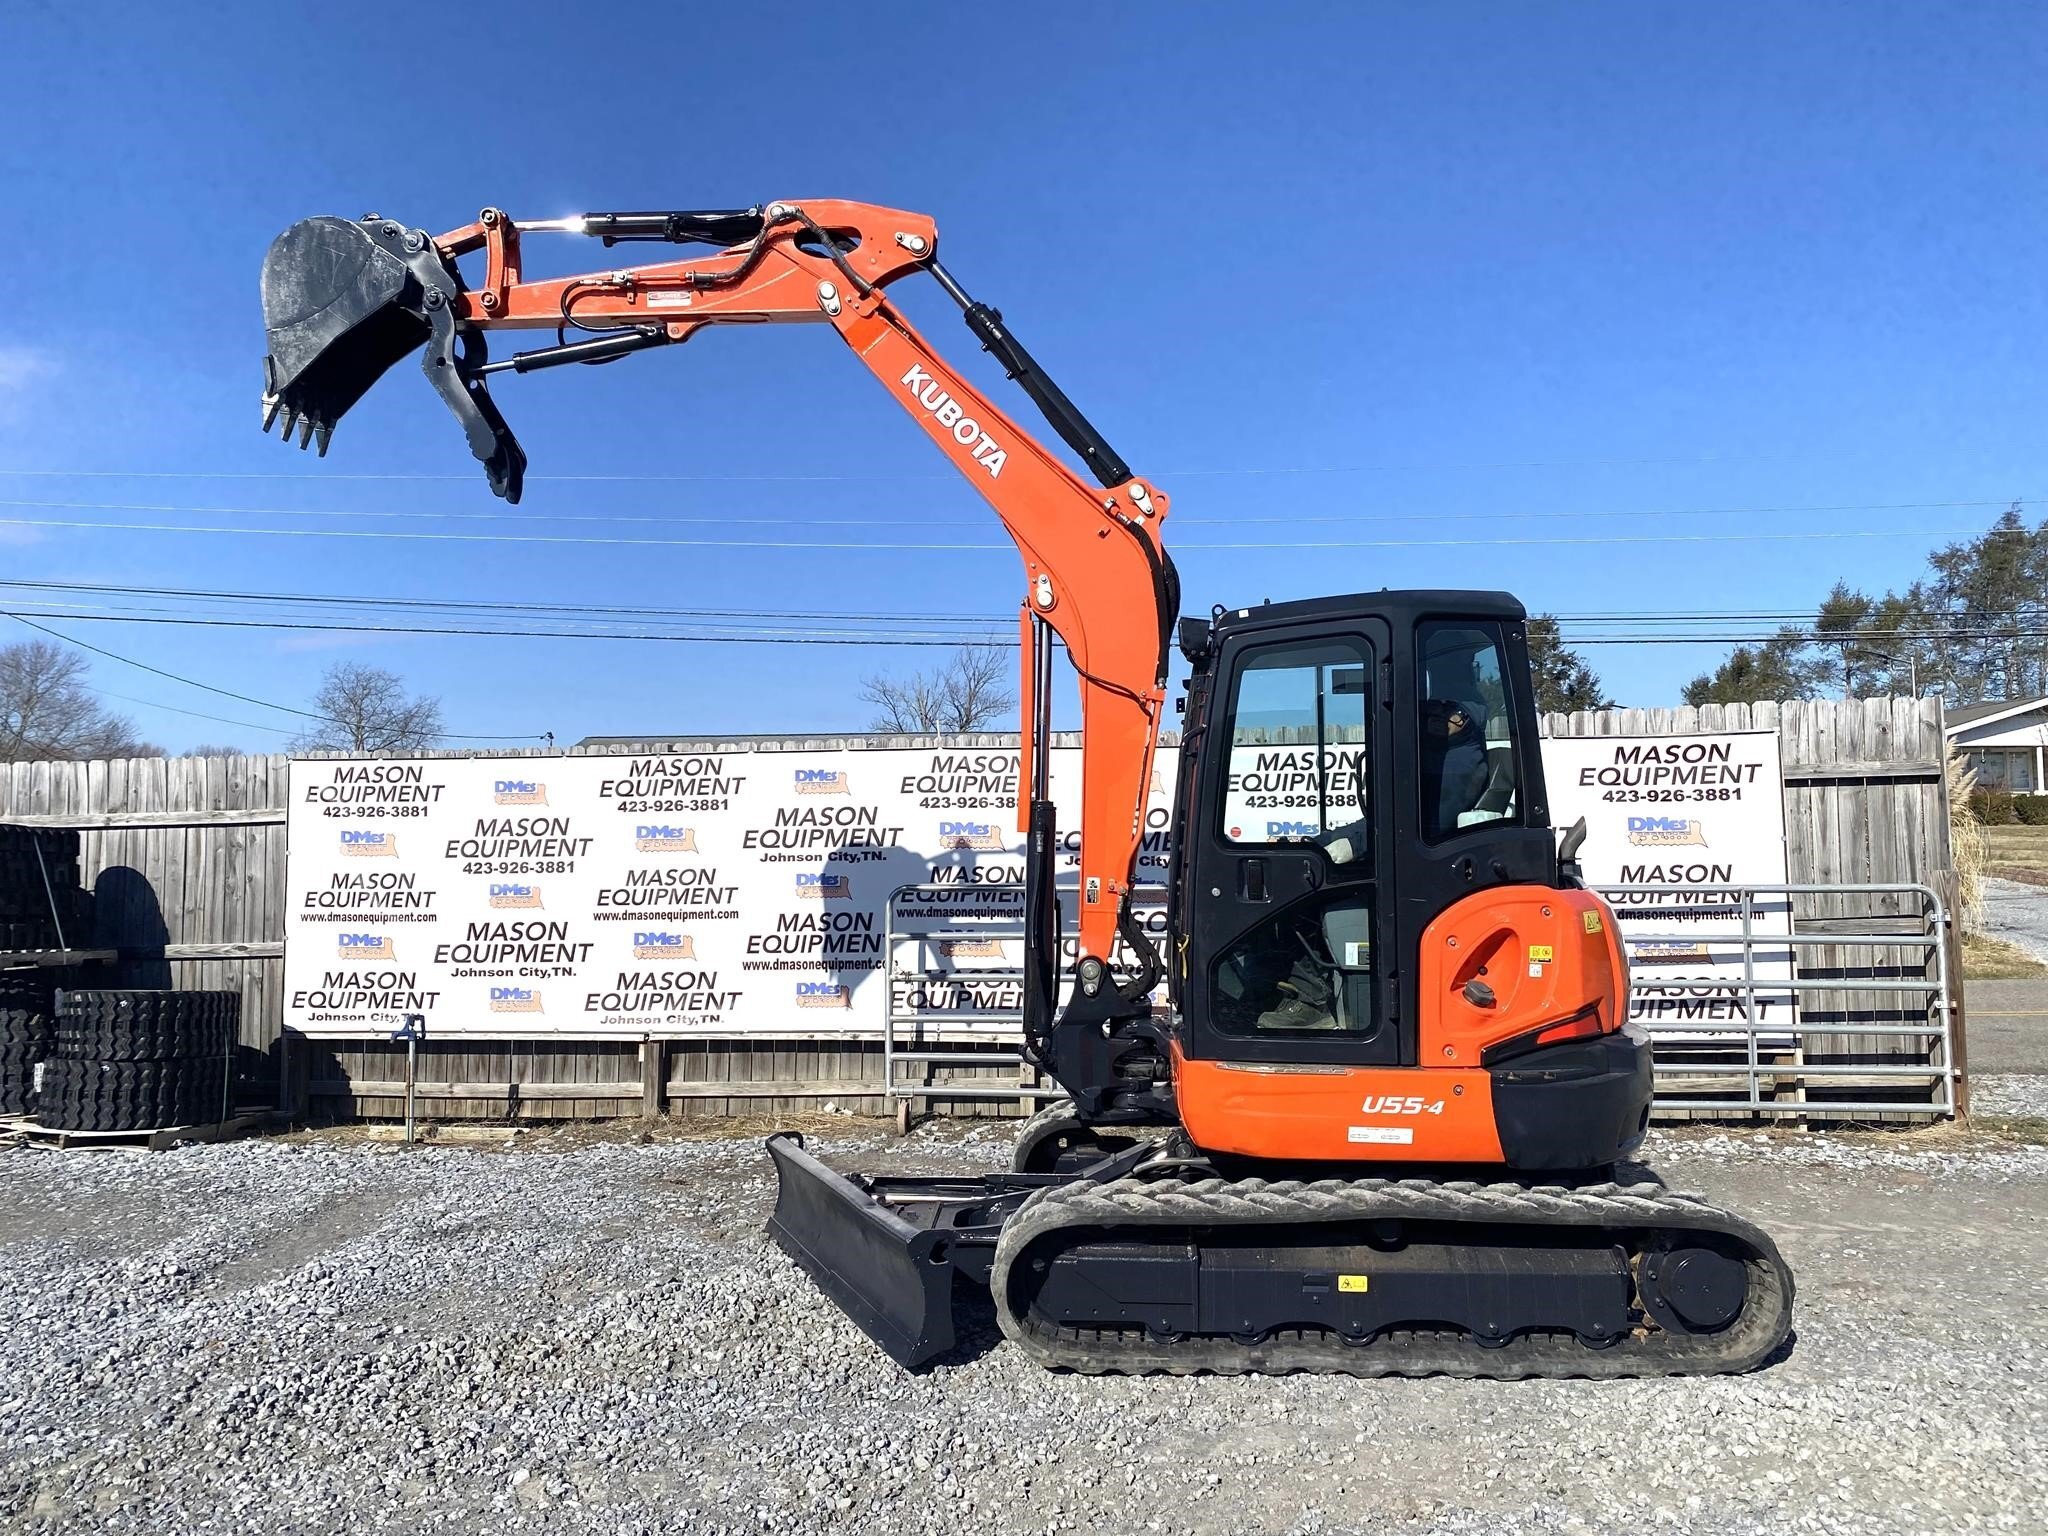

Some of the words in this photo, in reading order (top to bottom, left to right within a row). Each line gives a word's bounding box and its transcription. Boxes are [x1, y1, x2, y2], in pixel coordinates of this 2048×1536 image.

[900, 362, 1008, 480] KUBOTA
[1256, 751, 1359, 771] MASON
[1614, 742, 1732, 765] MASON
[333, 765, 424, 784] MASON
[629, 757, 723, 778] MASON
[1578, 763, 1763, 787] EQUIPMENT
[599, 776, 747, 798] EQUIPMENT
[900, 776, 1054, 794] EQUIPME
[1228, 772, 1366, 792] EQUIPMEN
[305, 784, 446, 804] EQUIPMENT
[919, 797, 1019, 808] 423-926-38
[1245, 795, 1357, 808] 423-926-388
[1602, 787, 1742, 803] 423-926-3881
[322, 805, 428, 818] 423-926-3881
[617, 798, 728, 813] 423-926-3881
[774, 806, 878, 827] MASON
[474, 817, 570, 838] MASON
[743, 827, 904, 849] EQUIPMENT
[444, 838, 594, 859] EQUIPMENT
[760, 852, 822, 863] Johnson
[462, 860, 574, 875] 423-926-3881
[930, 866, 1024, 884] MASON
[1620, 864, 1733, 884] MASON
[330, 872, 416, 890] MASON
[625, 868, 717, 887] MASON
[304, 890, 437, 908] EQUIPMENT
[596, 886, 739, 907] EQUIPMENT
[300, 911, 437, 925] www.dmasonequipment.com
[592, 908, 739, 923] www.dmasonequipment.com
[777, 912, 873, 932] MASON
[896, 906, 1024, 920] www.dmasonequipment
[1617, 908, 1765, 923] dmasonequipment.cm
[466, 921, 569, 942] MASON
[433, 942, 595, 964] EQUIPMENT
[746, 934, 886, 954] EQUIPMEN
[450, 967, 514, 978] Johnson
[742, 958, 898, 973] www.dmasonequipment.c
[321, 971, 417, 990] MASON
[616, 971, 718, 991] MASON
[291, 990, 441, 1010] EQUIPMENT
[584, 991, 743, 1012] EQUIPMENT
[892, 990, 1024, 1010] EQUIPME
[1631, 998, 1775, 1020] UIPMENT
[307, 1012, 366, 1022] Johnson
[600, 1015, 661, 1025] Johnson
[1361, 1096, 1445, 1115] U55-4
